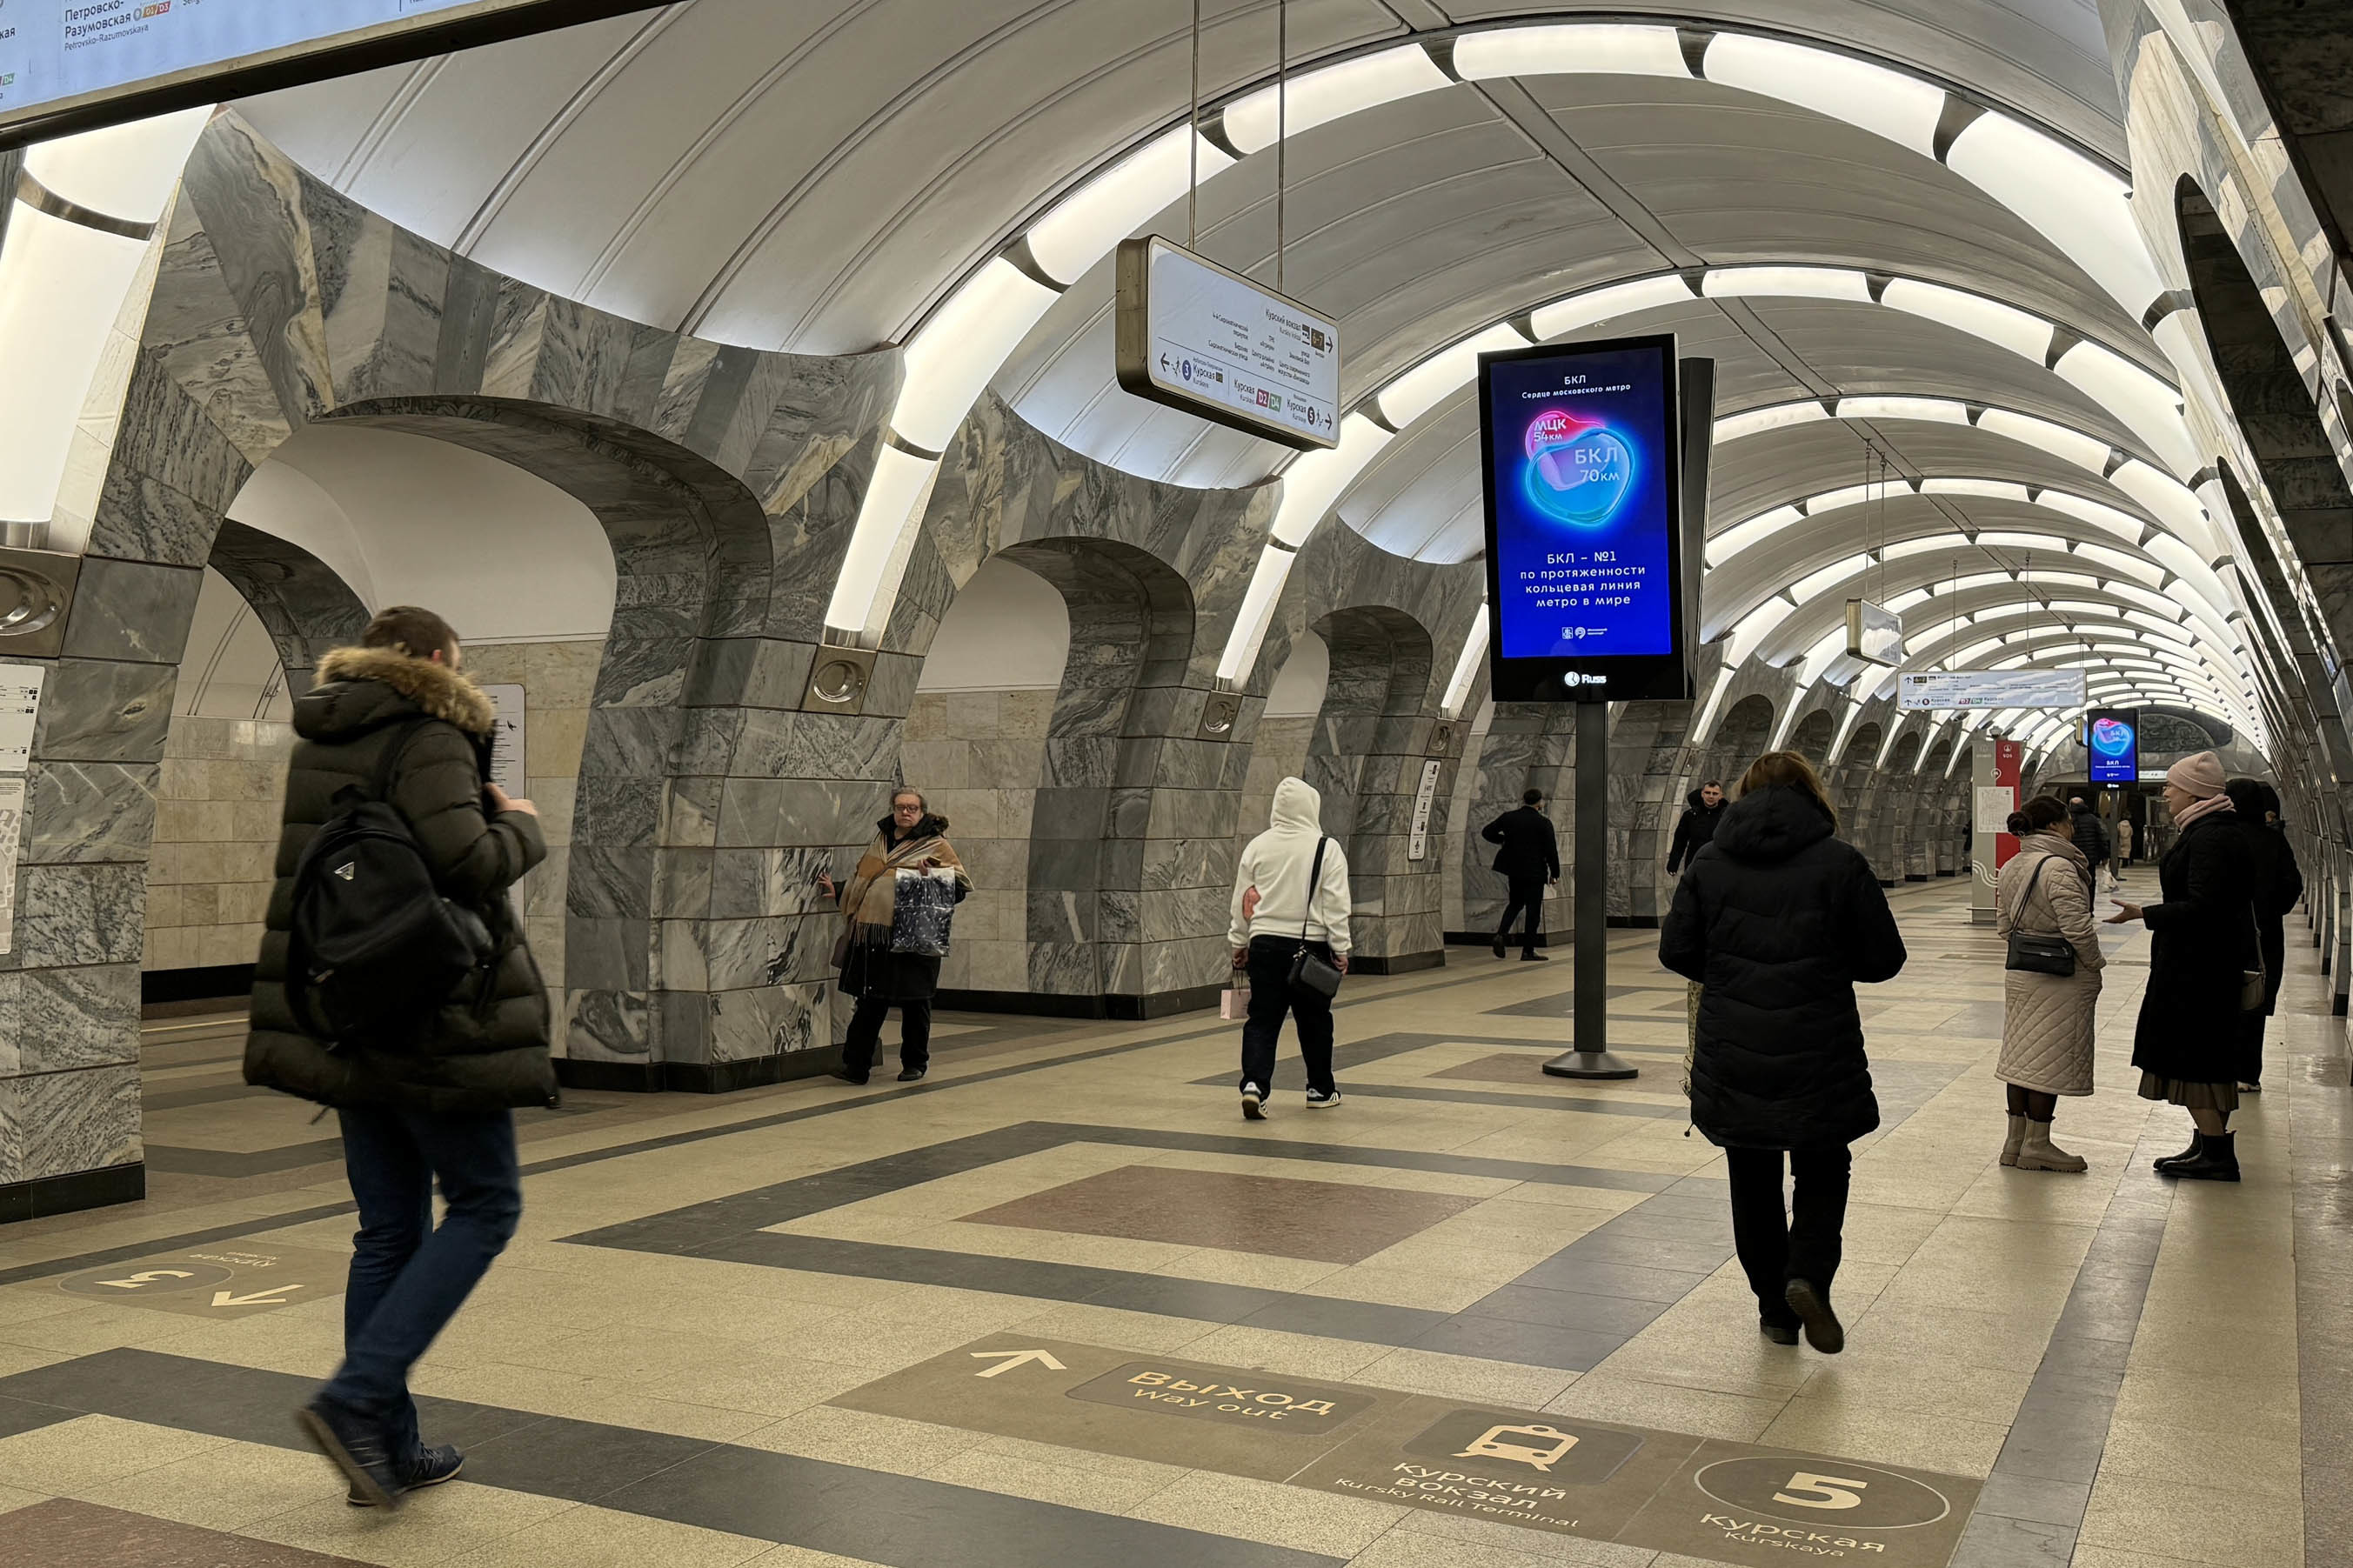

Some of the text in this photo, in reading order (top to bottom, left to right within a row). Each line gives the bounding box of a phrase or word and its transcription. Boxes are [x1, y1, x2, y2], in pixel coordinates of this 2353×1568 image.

[65, 0, 124, 22] Петровско-
[65, 13, 131, 38] Разумовская
[64, 23, 149, 51] Petrovsko-Razumovskaya
[1266, 308, 1285, 324] Курский
[1193, 363, 1215, 380] Курская
[1233, 378, 1255, 394] Курская
[1564, 375, 1586, 385] БКЛ
[1522, 384, 1631, 399] Сердце московского метро
[1287, 398, 1307, 413] Курская
[1534, 418, 1567, 431] МЦК
[1574, 446, 1618, 464] БКЛ
[1547, 552, 1575, 564] БКЛ
[1594, 550, 1616, 562] №1
[1520, 566, 1646, 580] по протяженности
[1526, 581, 1641, 594] кольцевая линия
[1536, 596, 1631, 608] метро в мире
[1581, 673, 1608, 684] Russ
[1217, 1405, 1288, 1420] out
[1392, 1462, 1567, 1500] Курский
[1394, 1478, 1539, 1510] вокзал
[1772, 1471, 1868, 1510] 5
[1335, 1478, 1580, 1528] Kursky Rail Terminal
[1700, 1513, 1885, 1553] Курская
[1725, 1531, 1845, 1558] Kurskaya
